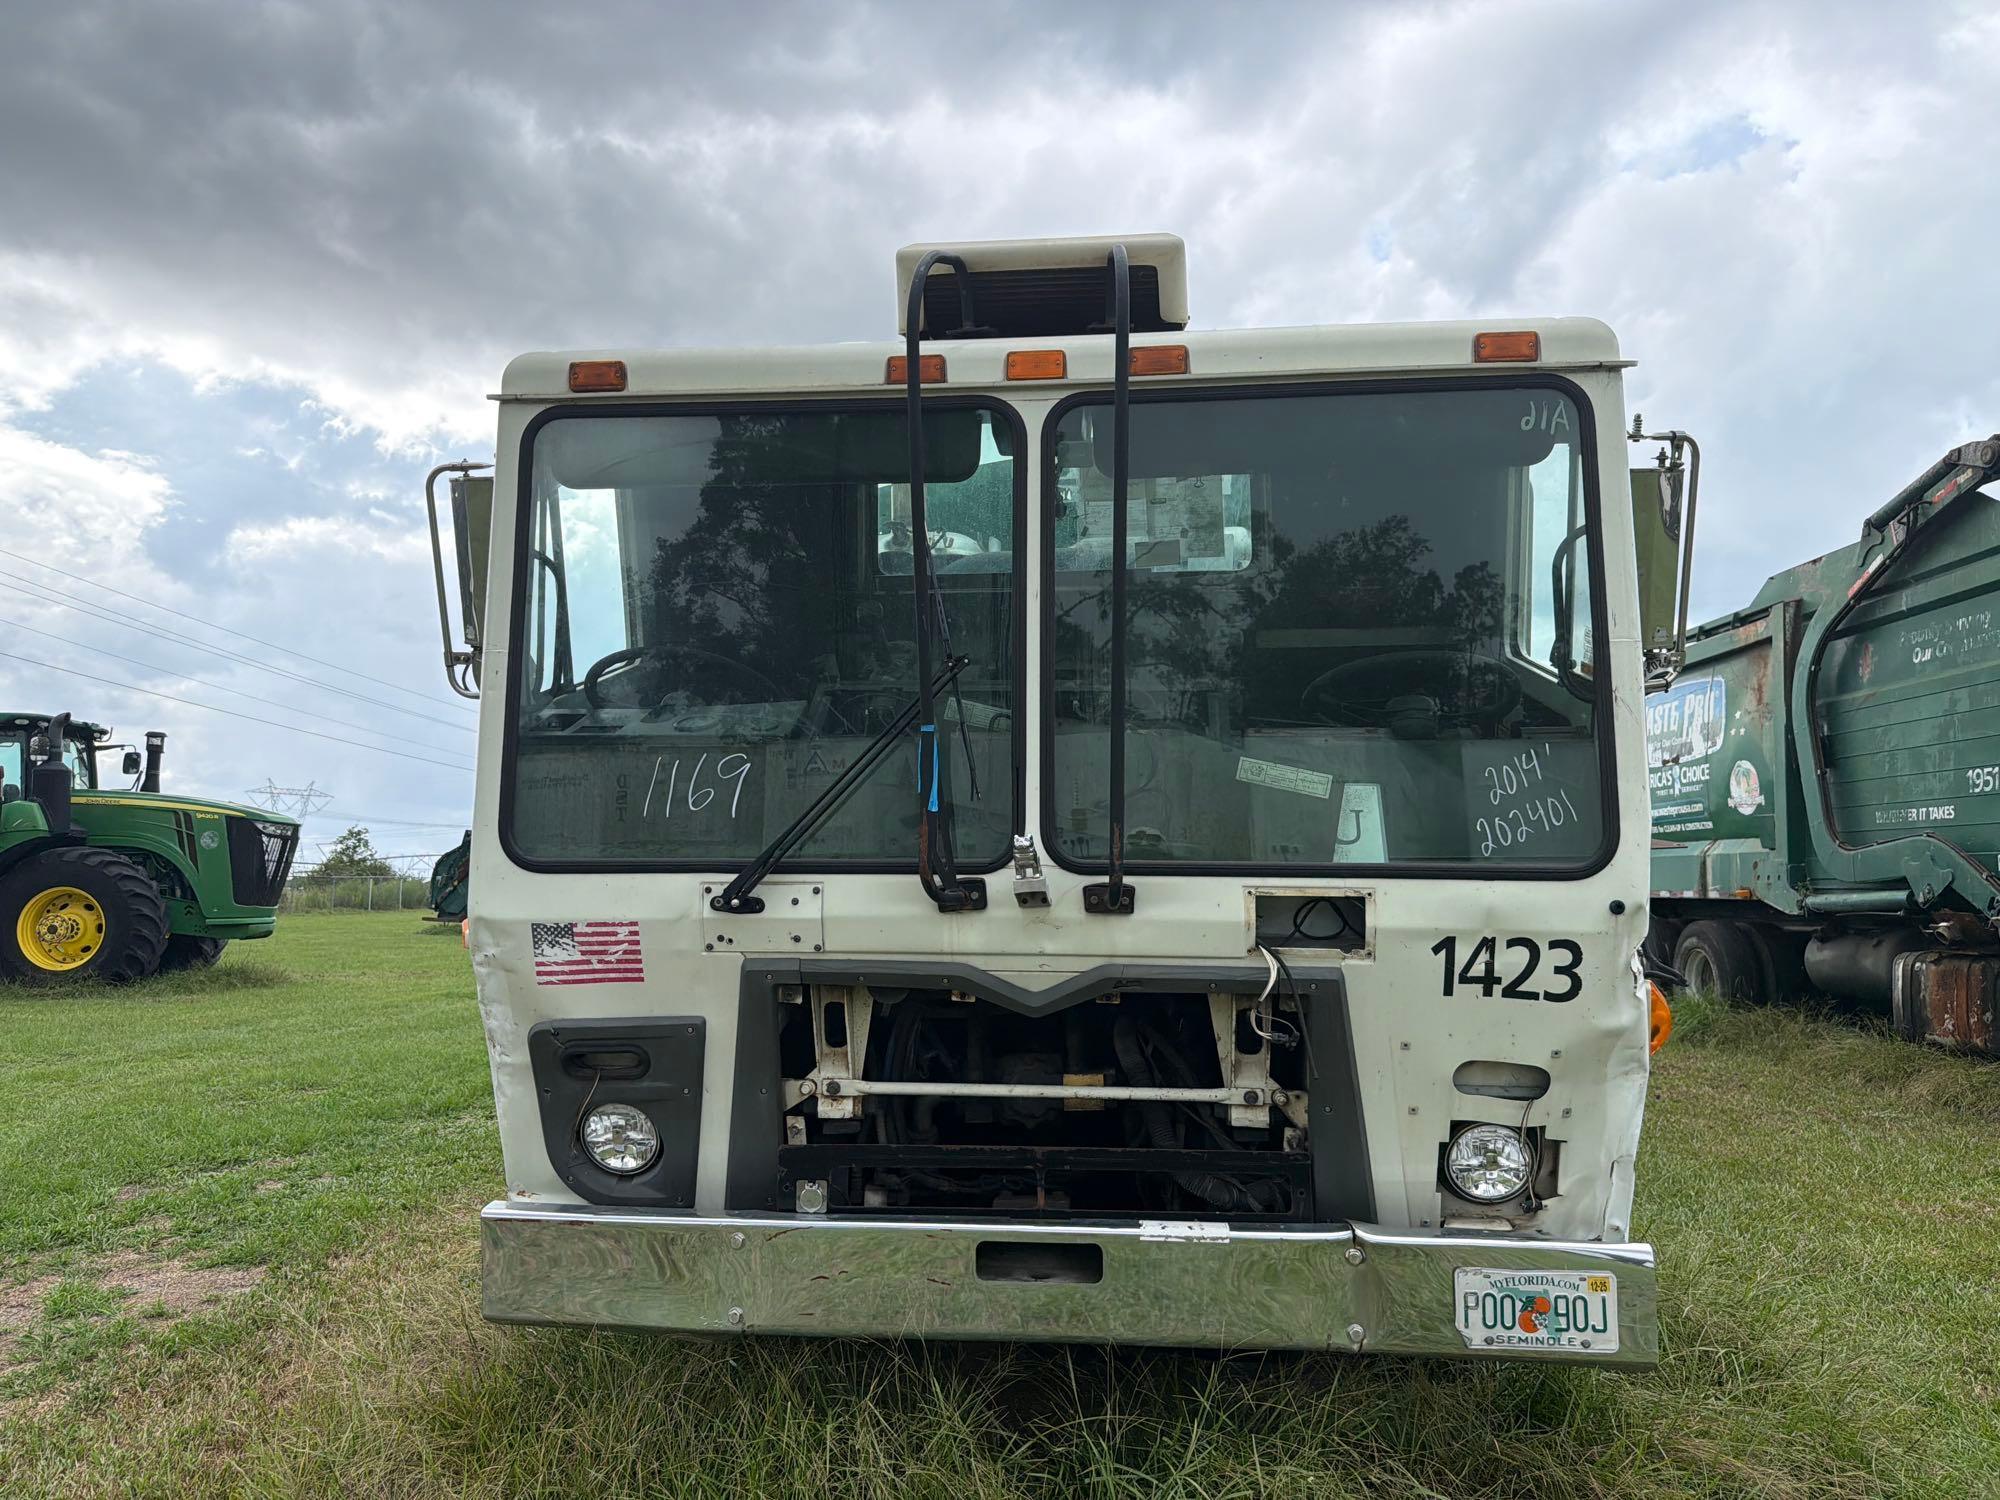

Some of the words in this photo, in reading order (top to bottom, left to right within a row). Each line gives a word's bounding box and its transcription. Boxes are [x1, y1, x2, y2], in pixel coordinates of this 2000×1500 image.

[1645, 700, 1679, 737] ASTE
[643, 753, 751, 818] 1169
[1650, 770, 1672, 788] RICA'S
[1681, 763, 1710, 784] CHOICE
[1476, 788, 1578, 857] 202401
[1919, 807, 1927, 820] IT
[1928, 805, 1955, 820] TAKES
[1431, 936, 1583, 1003] 1423
[1488, 1275, 1580, 1292] MYFLORIDA.COM
[1554, 1294, 1608, 1333] 90J
[1495, 1334, 1577, 1347] SEMINOLE
